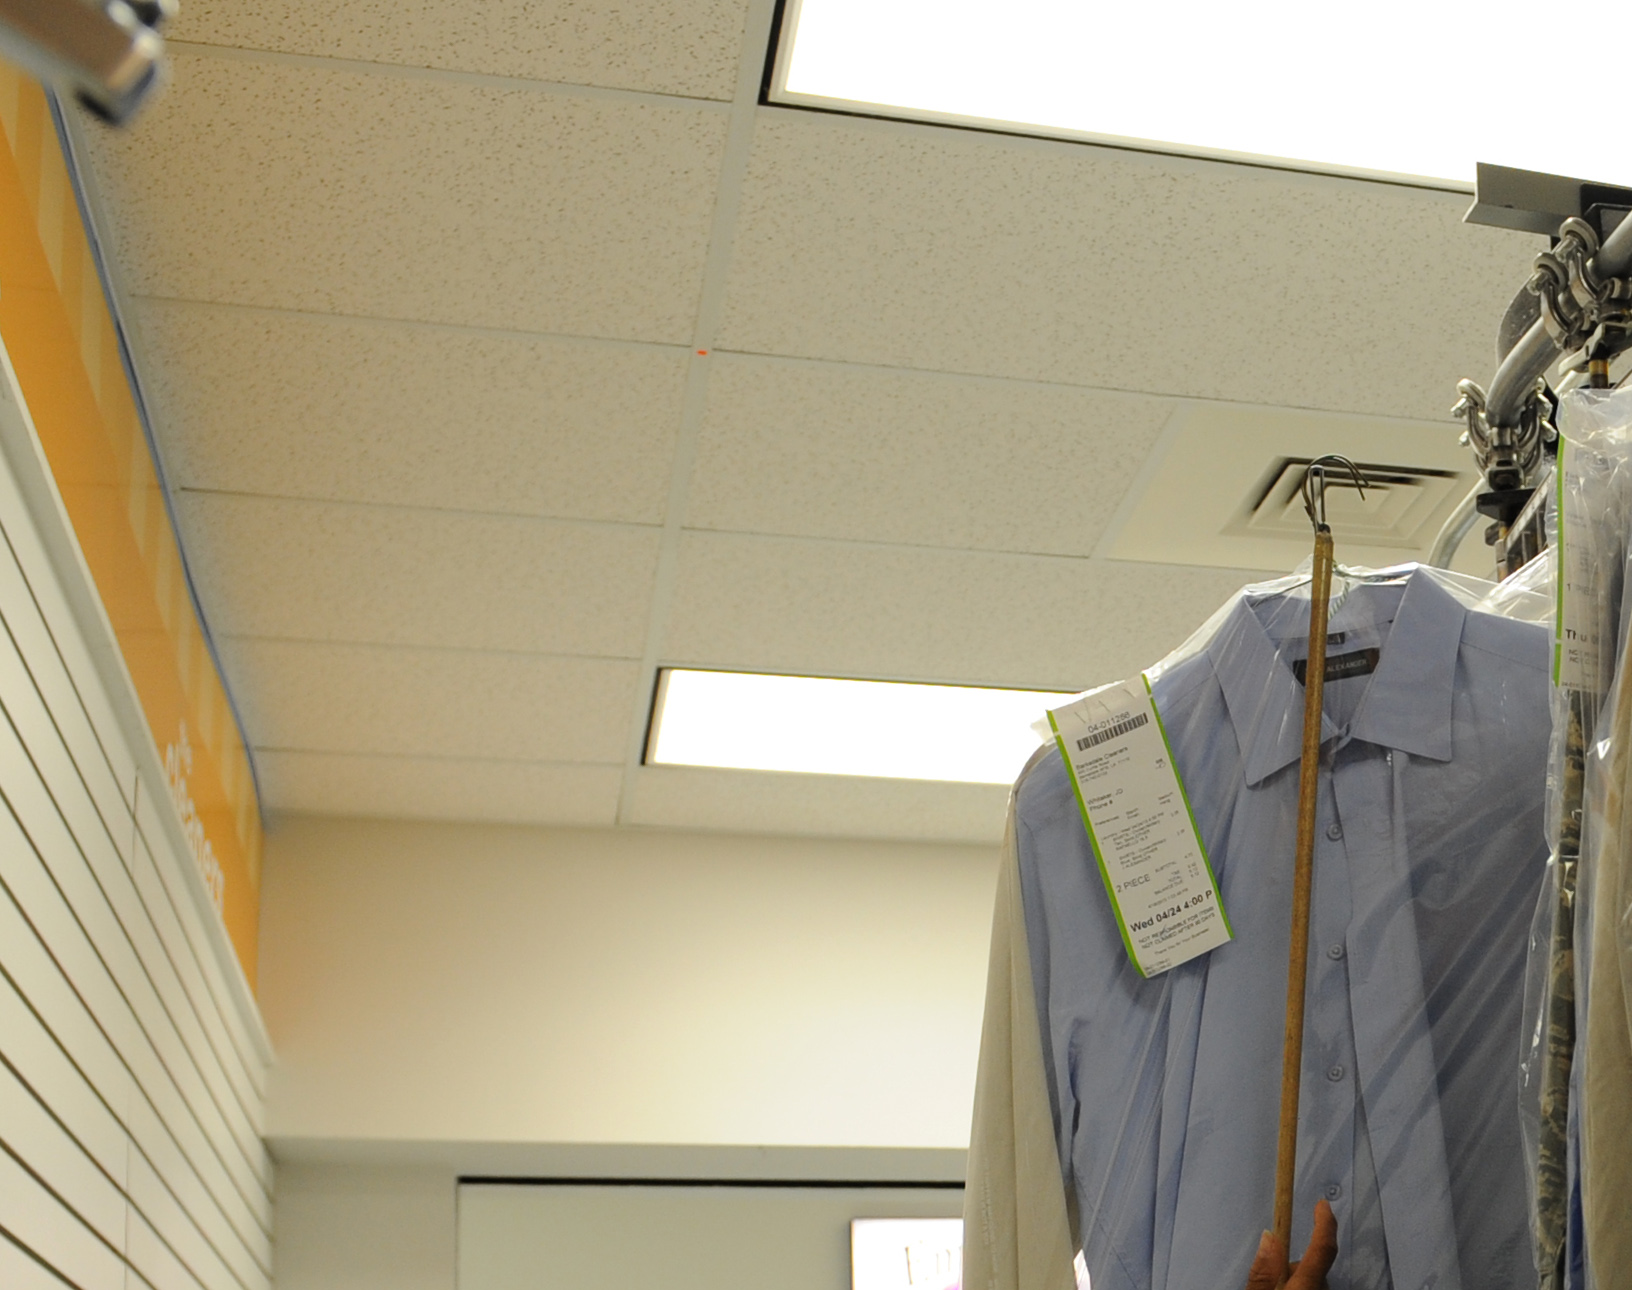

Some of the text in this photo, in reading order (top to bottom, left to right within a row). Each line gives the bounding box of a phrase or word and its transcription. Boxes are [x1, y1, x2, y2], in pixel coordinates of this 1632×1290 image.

[1115, 884, 1122, 892] 2
[1123, 872, 1150, 890] PIECE
[1129, 915, 1154, 933] Wed
[1154, 904, 1182, 922] 04/24
[1182, 894, 1204, 910] 4:00
[1204, 889, 1213, 899] P
[1138, 935, 1150, 944] NOT
[1187, 913, 1198, 922] FOR
[1141, 941, 1153, 949] NOT
[1177, 922, 1194, 933] AFTER
